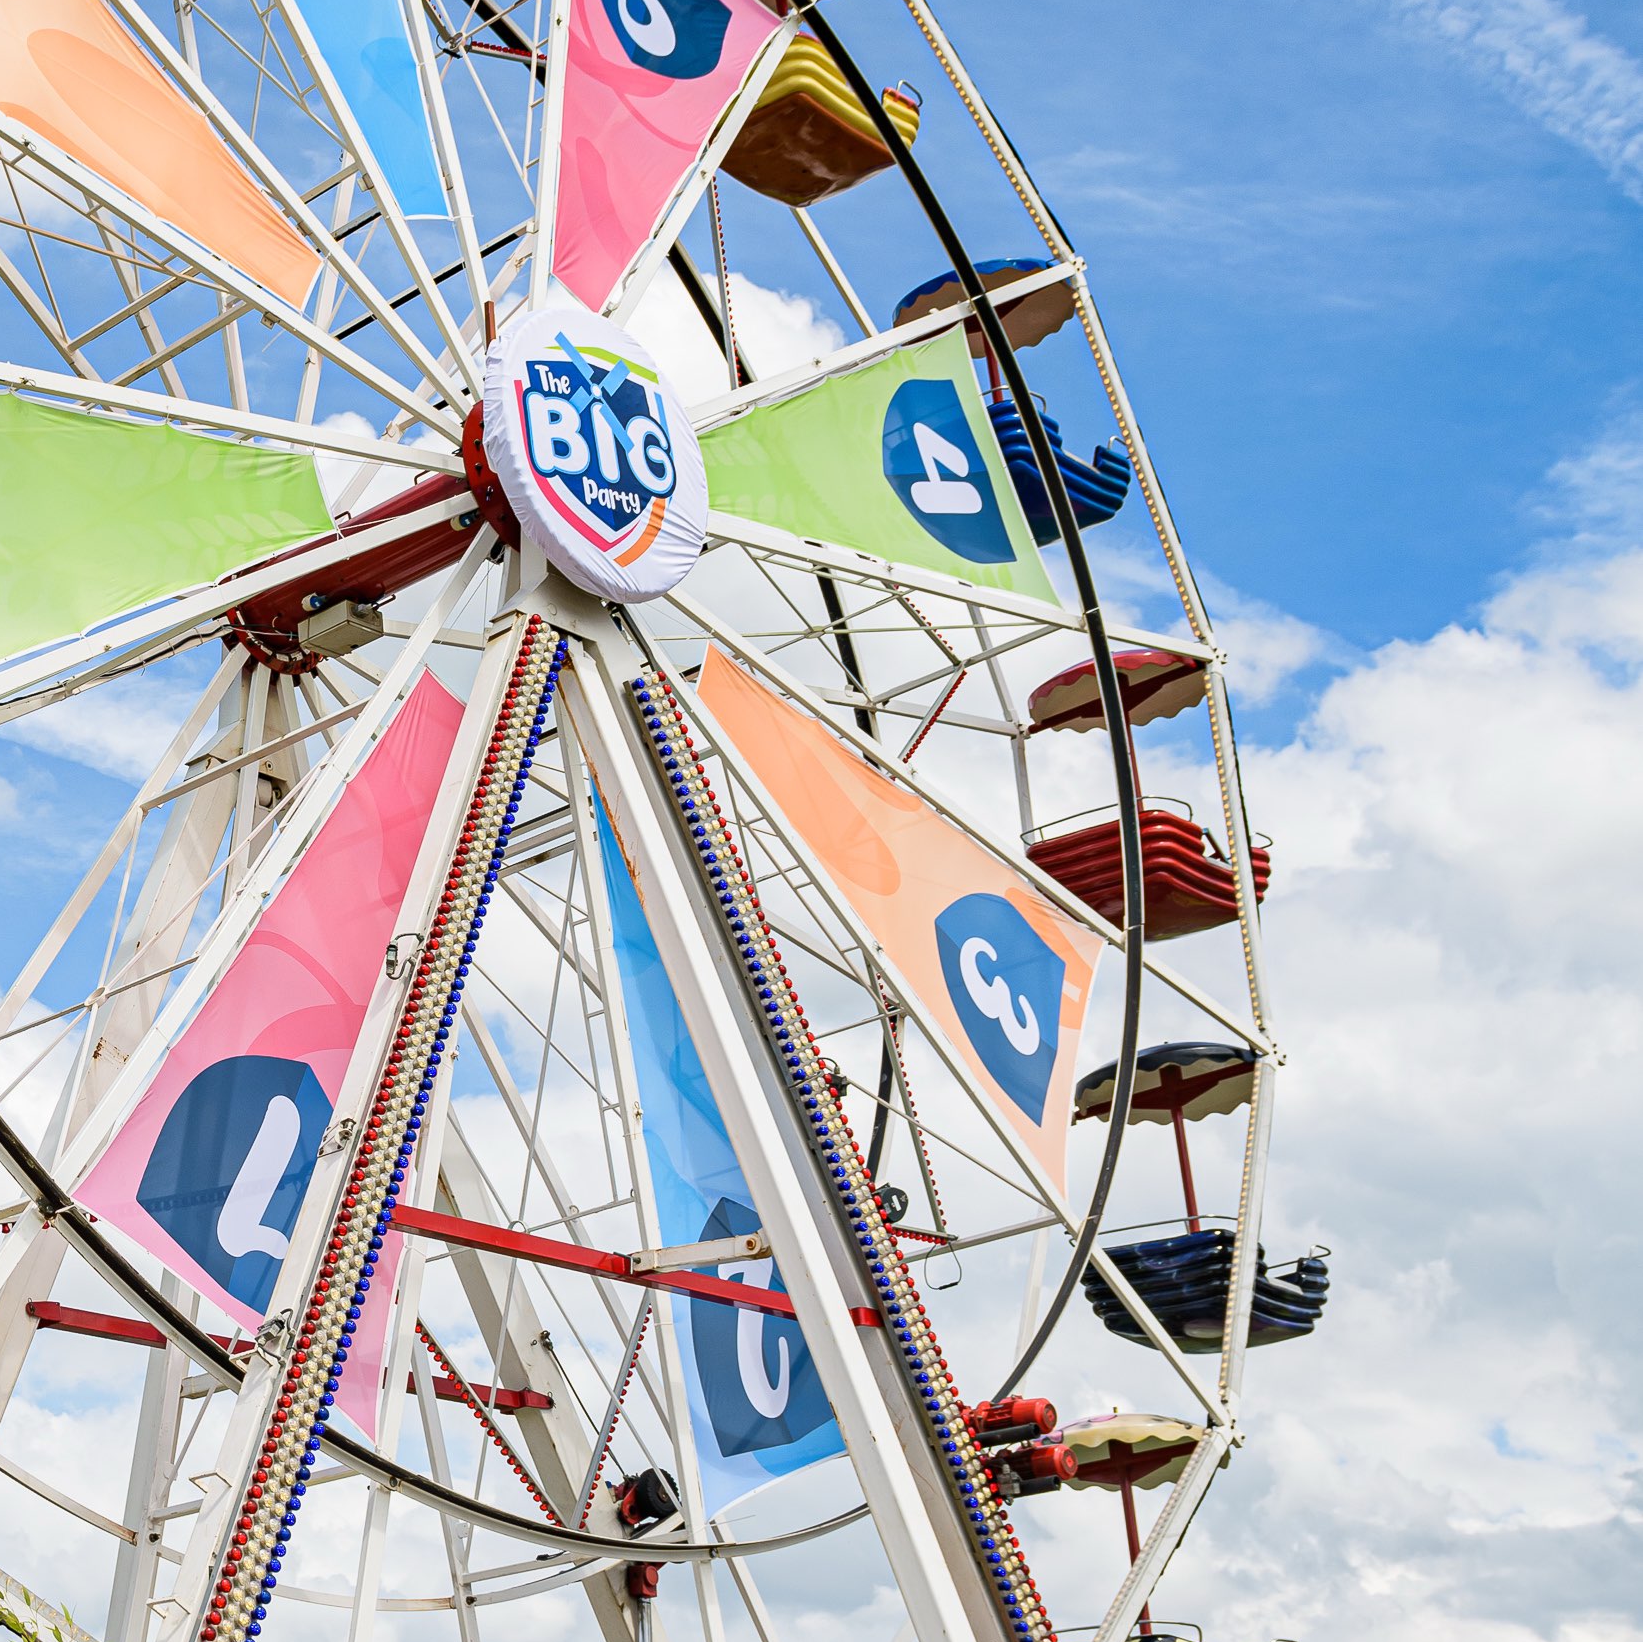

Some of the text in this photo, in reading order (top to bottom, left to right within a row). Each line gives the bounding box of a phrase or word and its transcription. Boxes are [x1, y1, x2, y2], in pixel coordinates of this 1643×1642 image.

[534, 364, 571, 395] The
[911, 421, 983, 515] 4
[959, 936, 1041, 1055] 3
